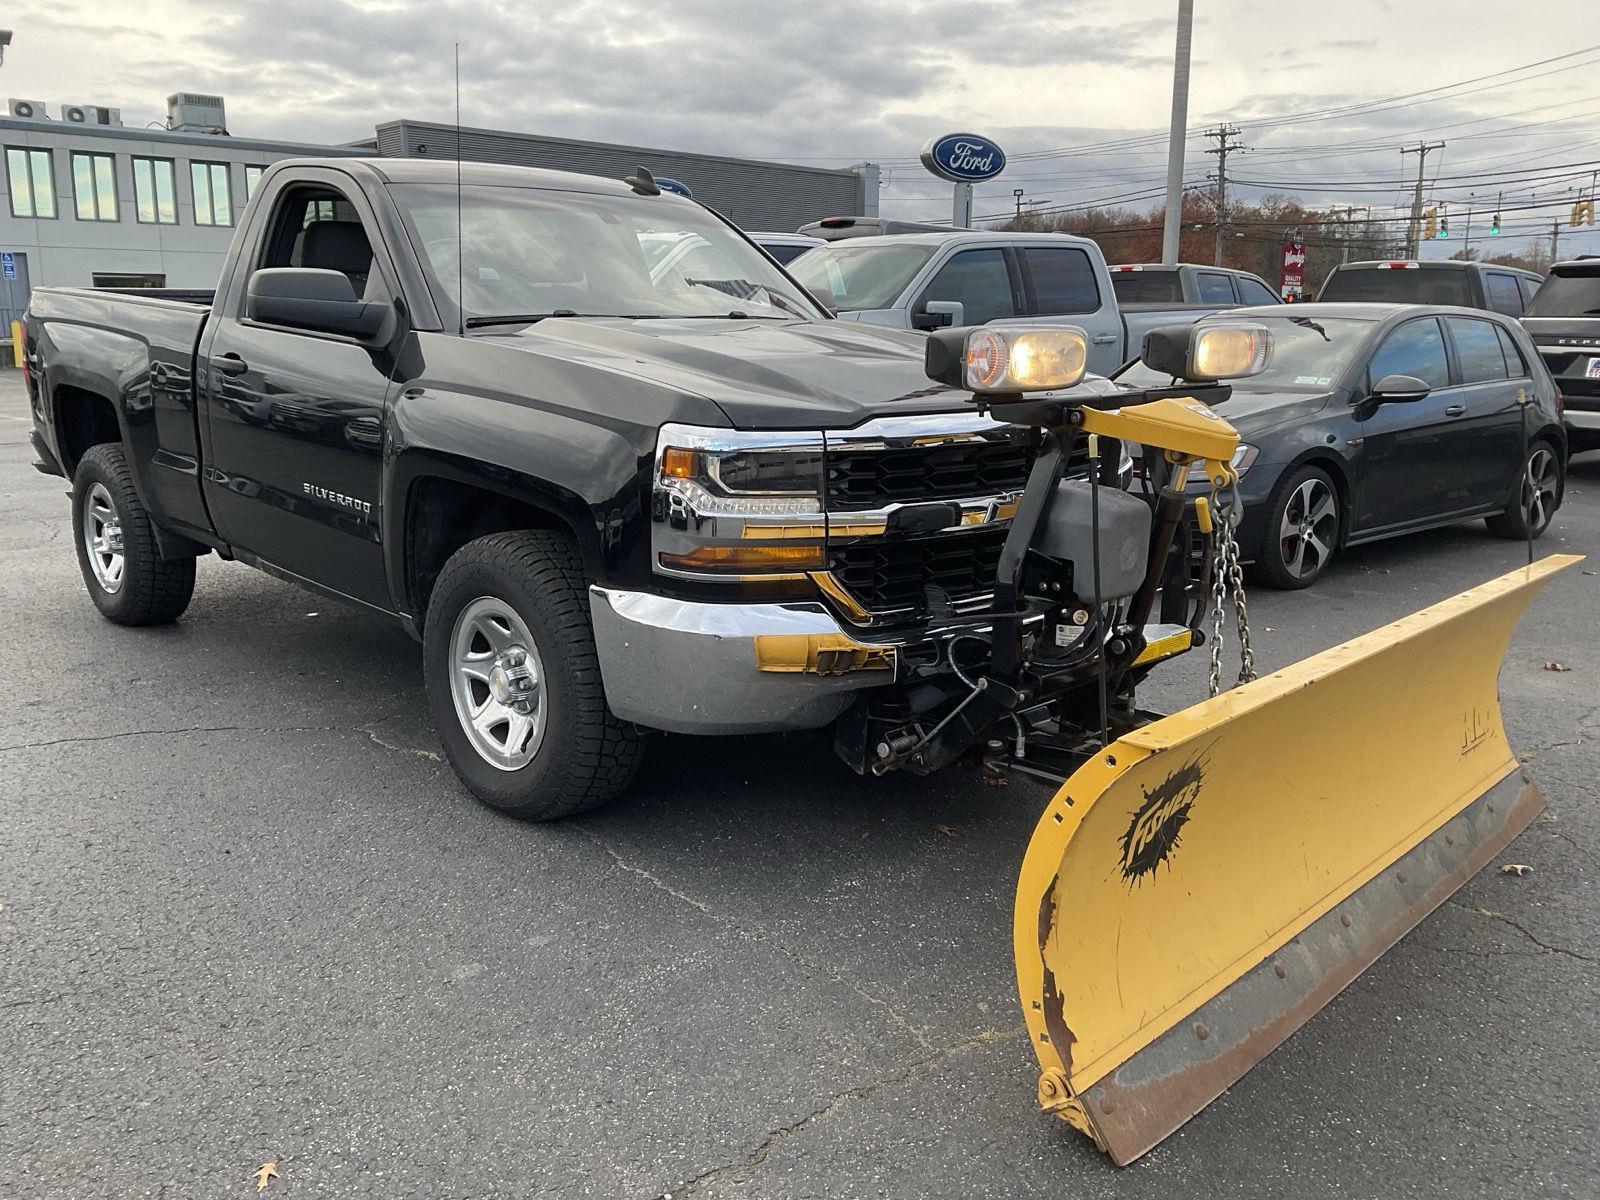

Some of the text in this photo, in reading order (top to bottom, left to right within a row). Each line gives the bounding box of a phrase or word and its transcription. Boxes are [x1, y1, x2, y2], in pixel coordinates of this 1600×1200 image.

[949, 142, 993, 171] Ford
[303, 482, 372, 513] SILVERADO
[1126, 780, 1200, 868] FISHER
